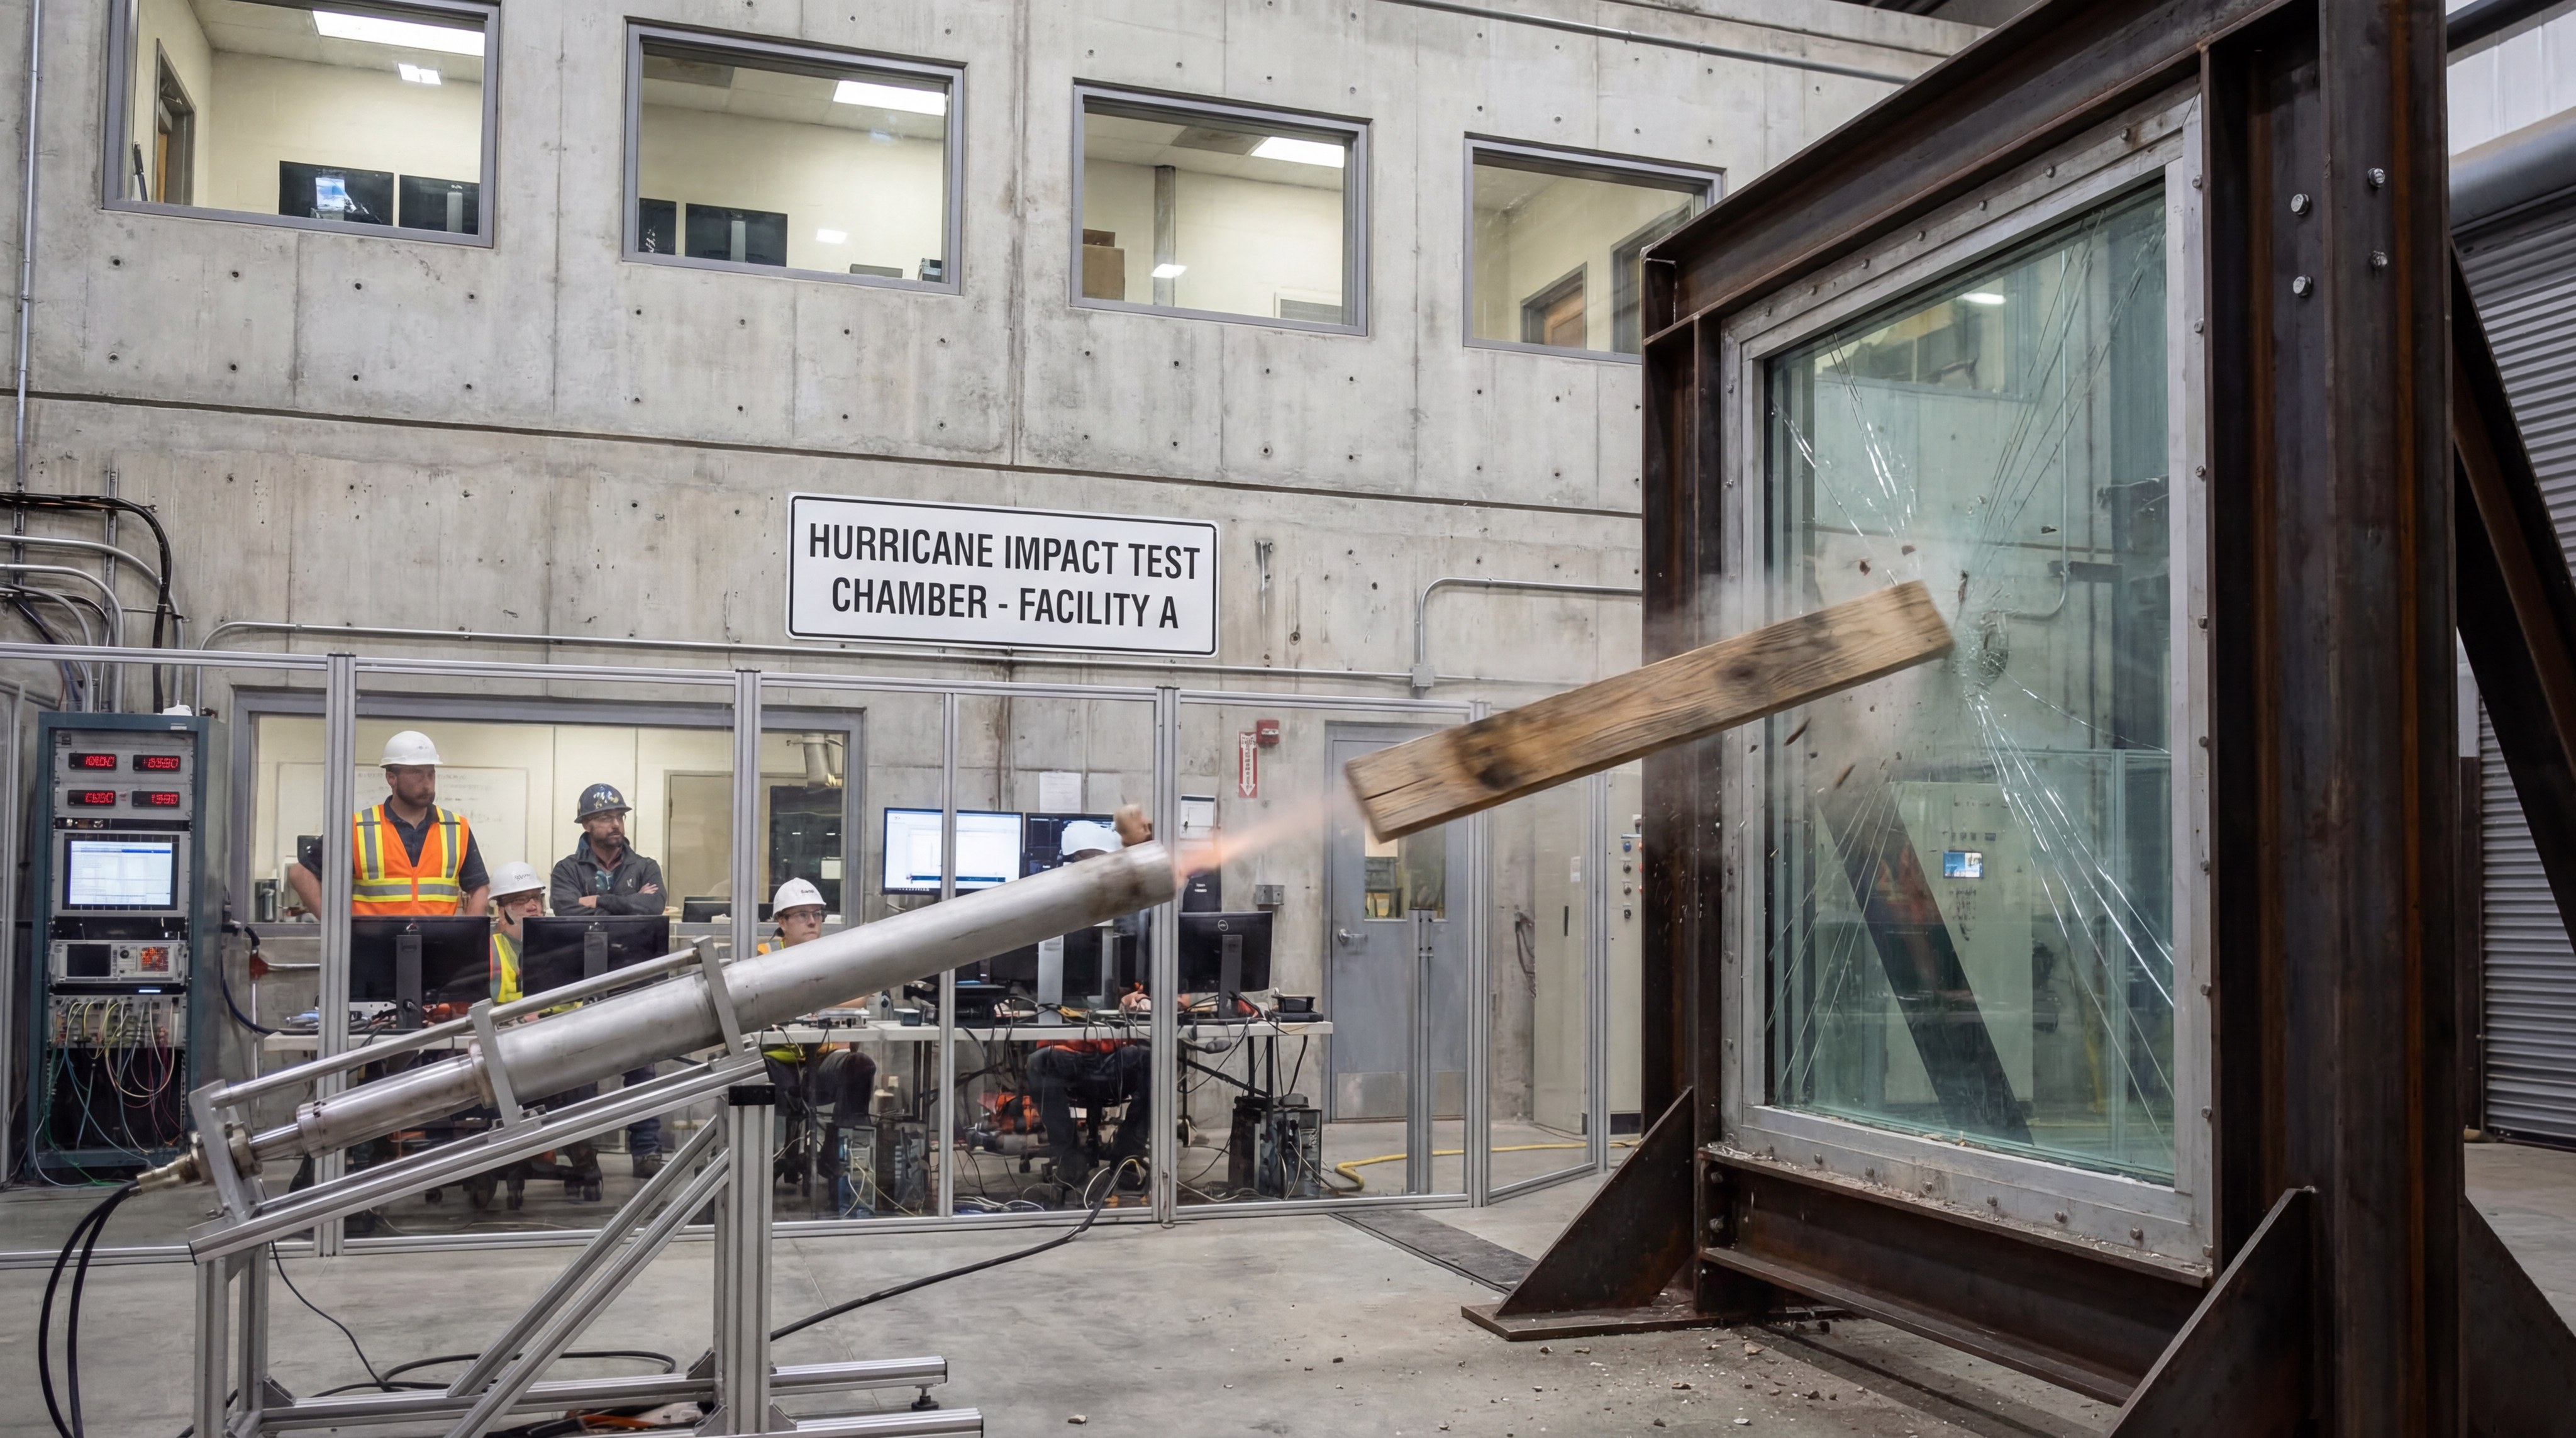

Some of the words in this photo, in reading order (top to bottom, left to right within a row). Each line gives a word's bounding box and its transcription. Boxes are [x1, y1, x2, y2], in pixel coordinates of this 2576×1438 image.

[809, 523, 993, 568] HURRICANE
[1005, 535, 1119, 575] IMPACT
[1128, 543, 1201, 579] TEST
[832, 577, 987, 619] CHAMBER
[1019, 588, 1150, 627] FACILITY
[1158, 596, 1179, 629] A
